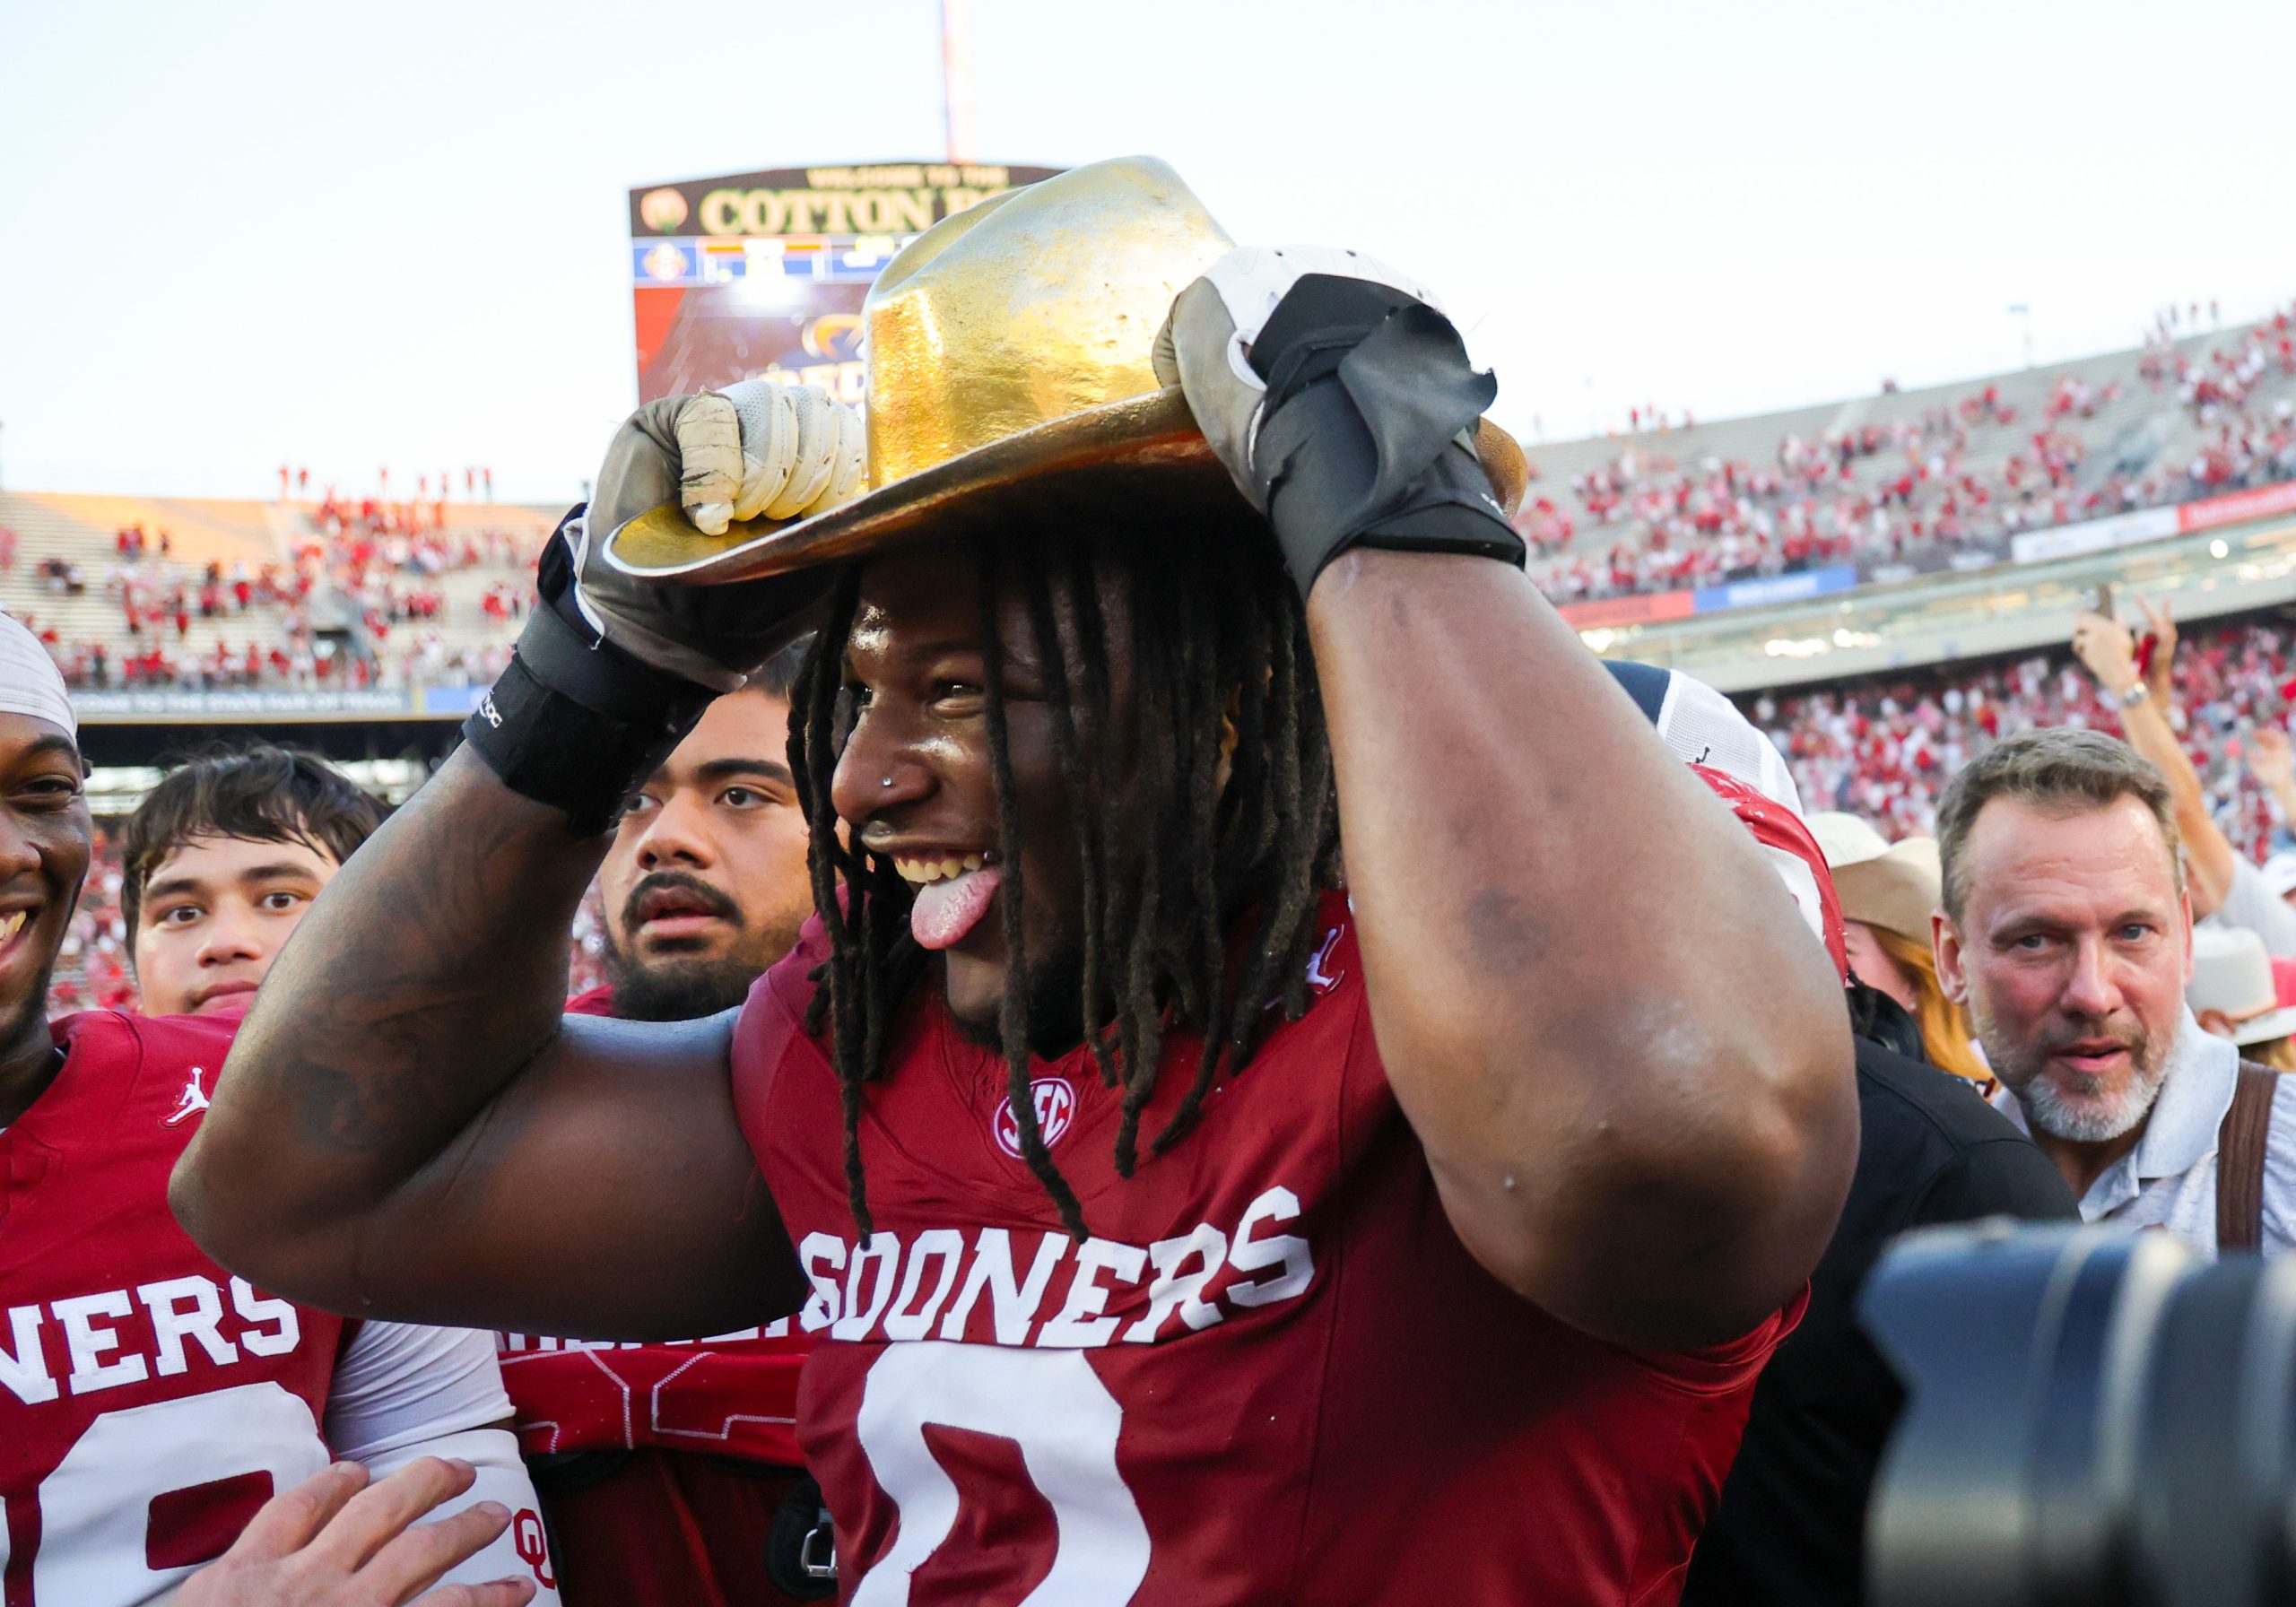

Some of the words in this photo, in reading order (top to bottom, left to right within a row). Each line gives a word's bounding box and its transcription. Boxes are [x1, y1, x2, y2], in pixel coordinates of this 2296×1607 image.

[926, 164, 961, 187] TO
[700, 187, 934, 235] COTTON
[800, 1185, 1315, 1348] SOONERS
